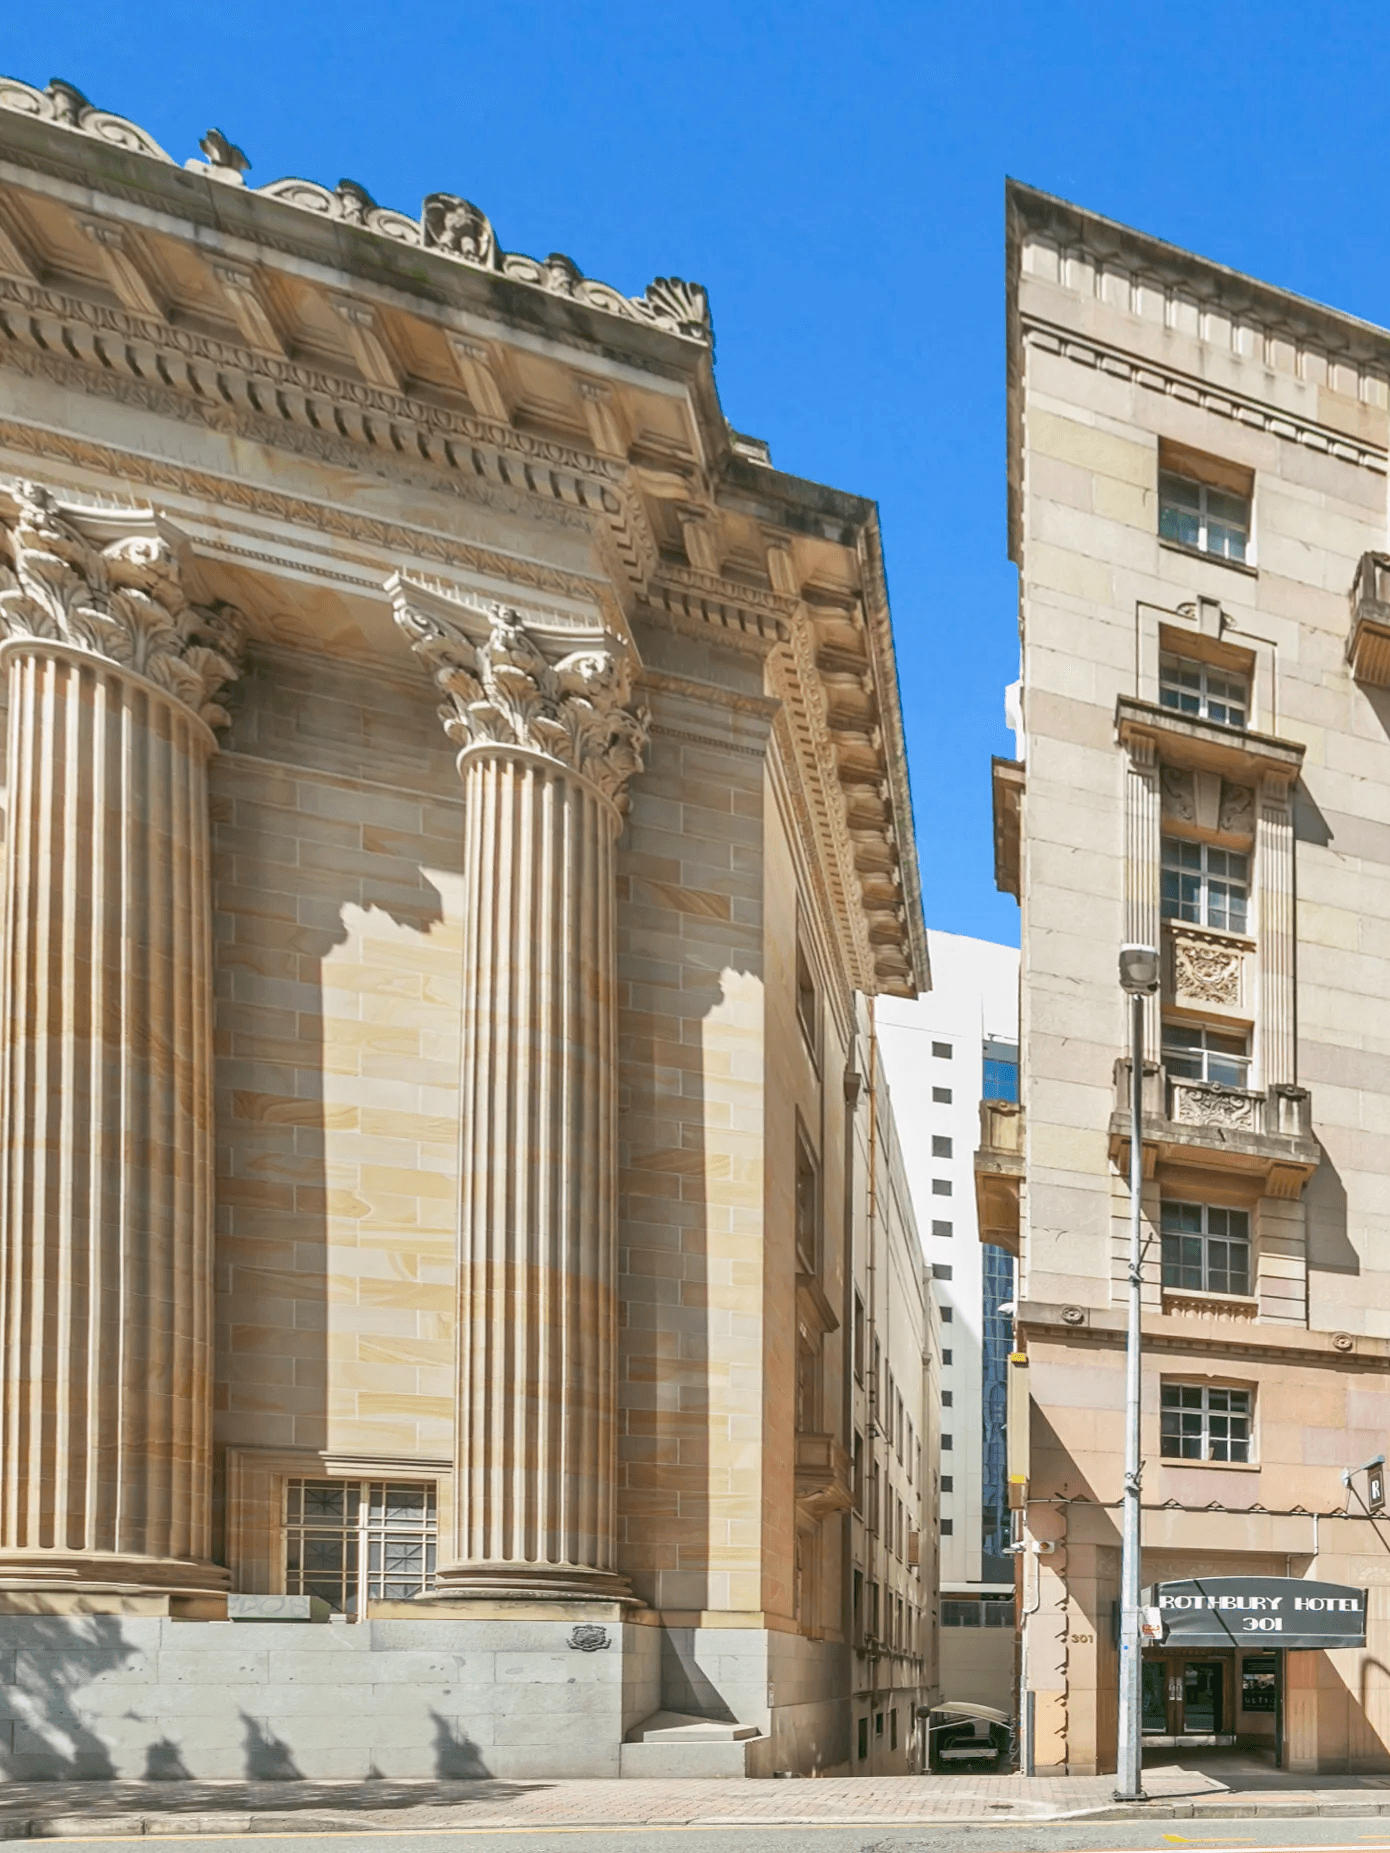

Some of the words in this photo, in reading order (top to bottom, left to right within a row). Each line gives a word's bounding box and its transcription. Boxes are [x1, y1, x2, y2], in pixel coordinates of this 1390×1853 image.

[1372, 1480, 1381, 1500] R
[1159, 1595, 1283, 1610] ROTHBURY
[1294, 1597, 1363, 1612] HOTEL
[1243, 1617, 1283, 1631] 301
[1071, 1633, 1094, 1644] 301
